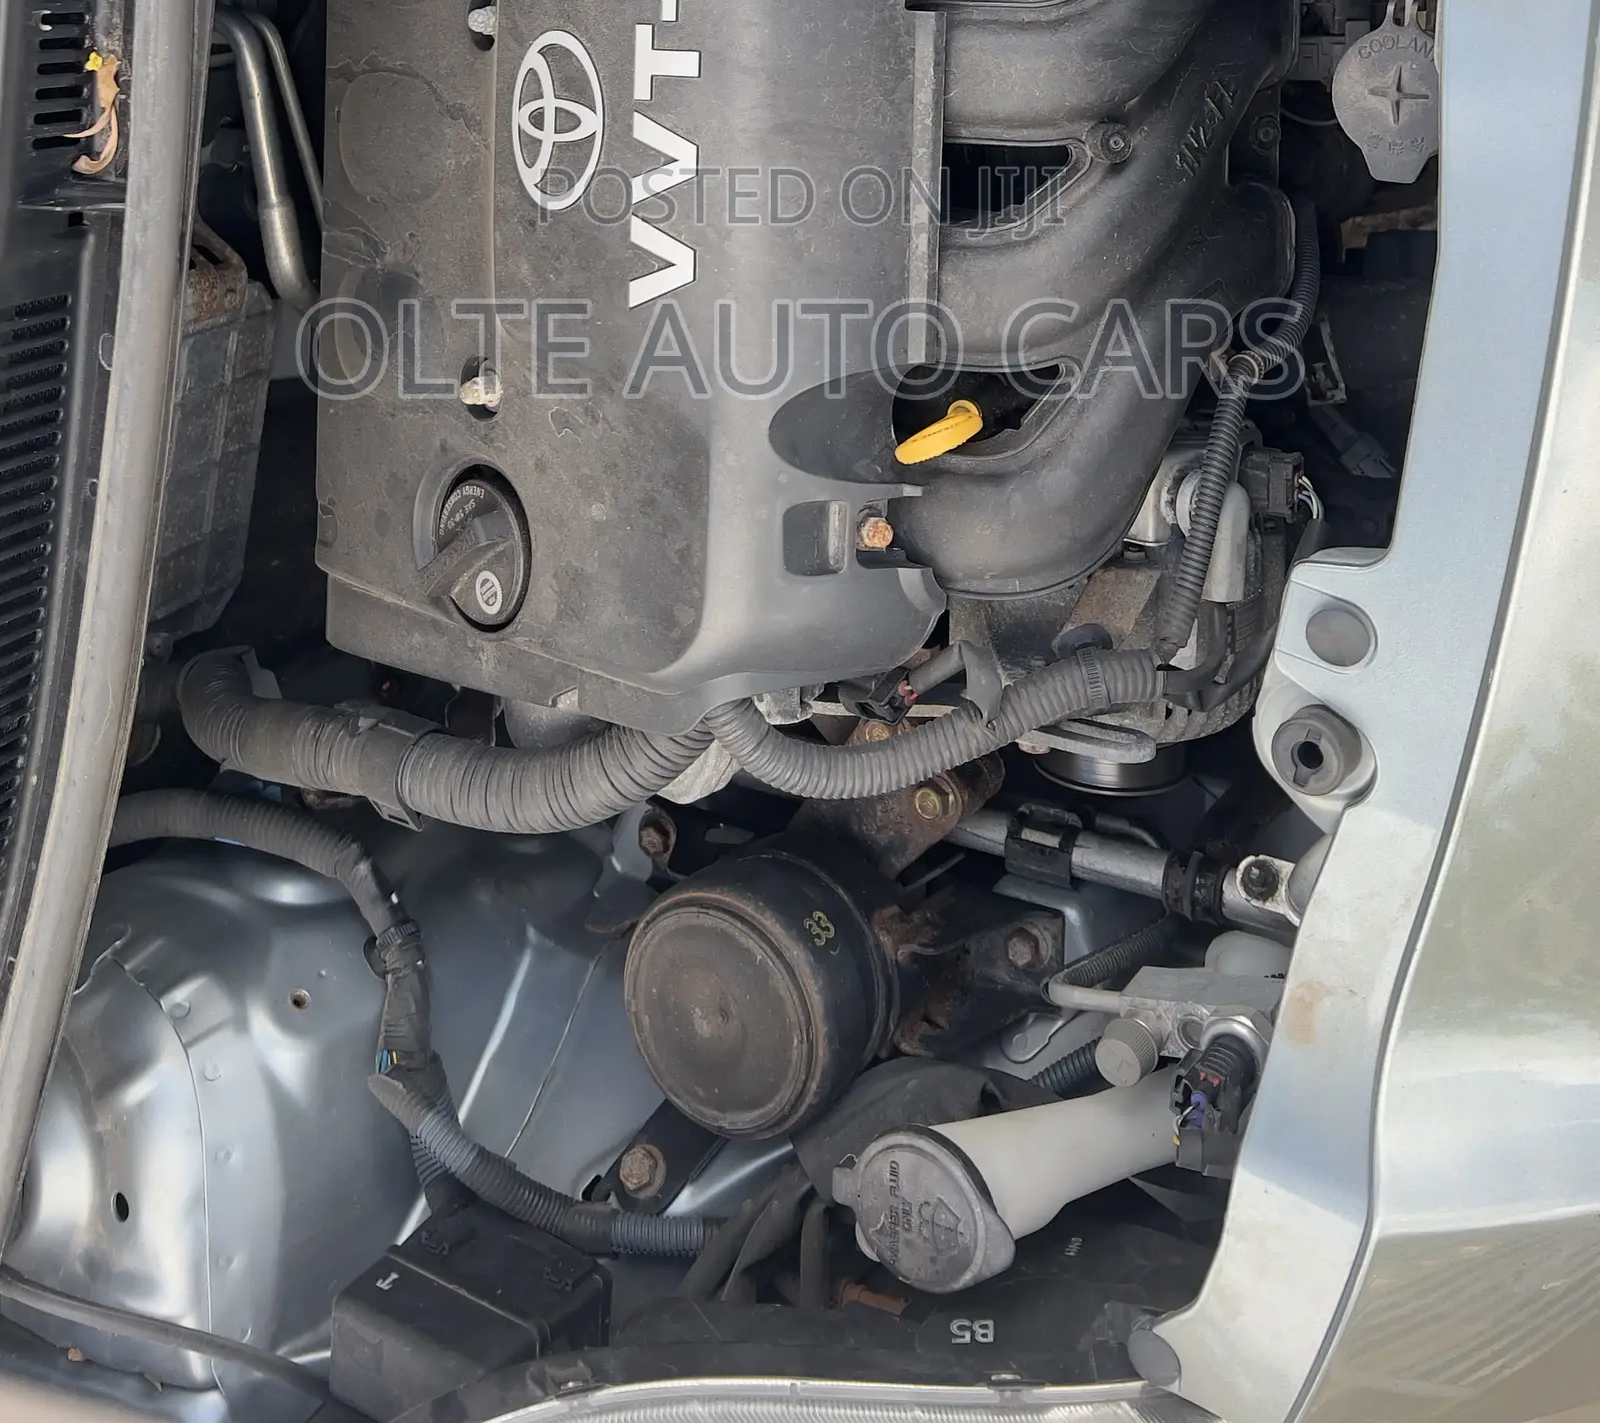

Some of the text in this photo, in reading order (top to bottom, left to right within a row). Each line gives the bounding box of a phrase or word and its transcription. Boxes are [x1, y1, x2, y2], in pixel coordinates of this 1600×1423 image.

[1358, 34, 1435, 62] COOLAN
[803, 910, 835, 947] 33
[889, 1160, 900, 1260] WASHER FLUID
[902, 1196, 912, 1232] ONLY
[950, 1319, 995, 1344] B5
